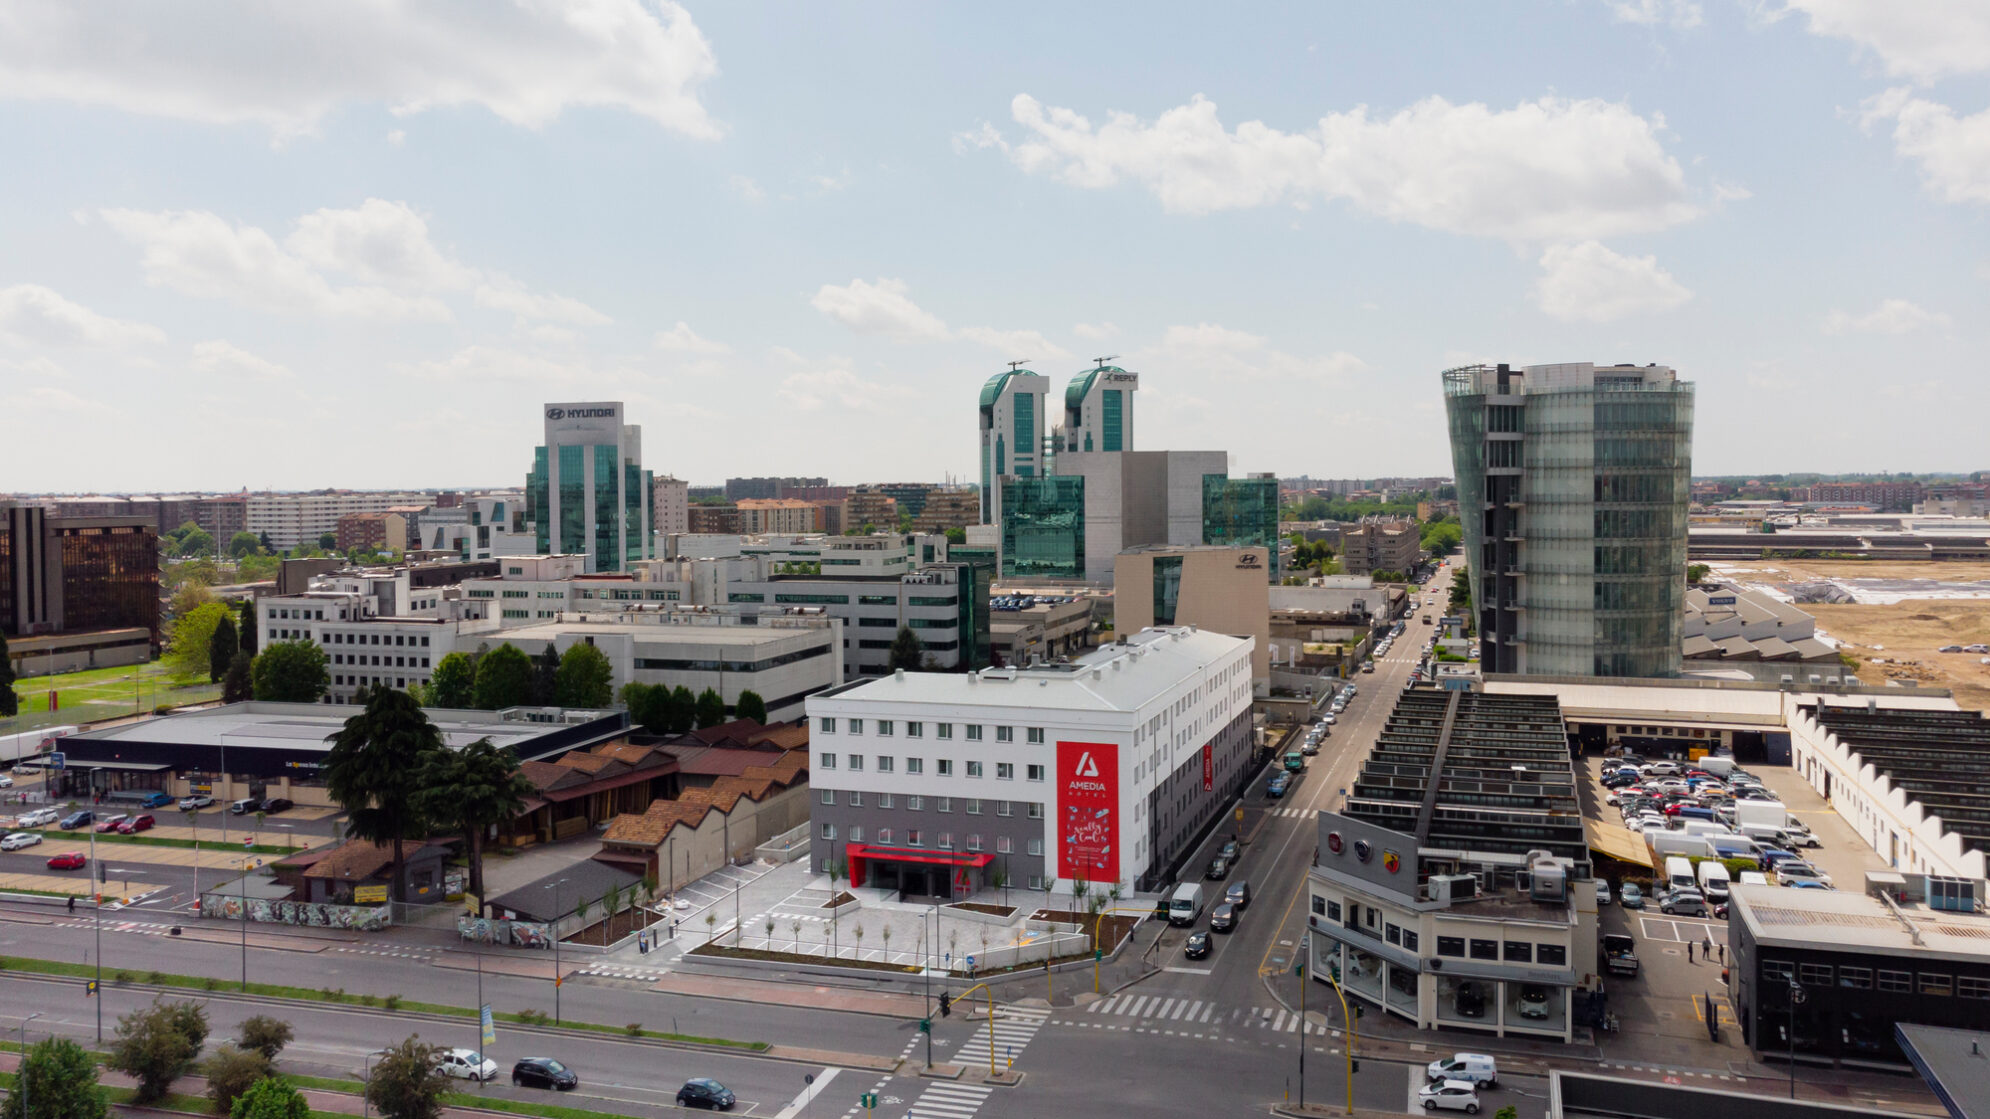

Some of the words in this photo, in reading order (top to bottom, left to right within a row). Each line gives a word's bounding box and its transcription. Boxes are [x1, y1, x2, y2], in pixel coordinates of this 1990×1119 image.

[1113, 374, 1137, 382] REPLY
[567, 408, 615, 418] HYUNDAI
[1069, 781, 1106, 791] AMEDIA
[1068, 791, 1107, 799] HOTEL
